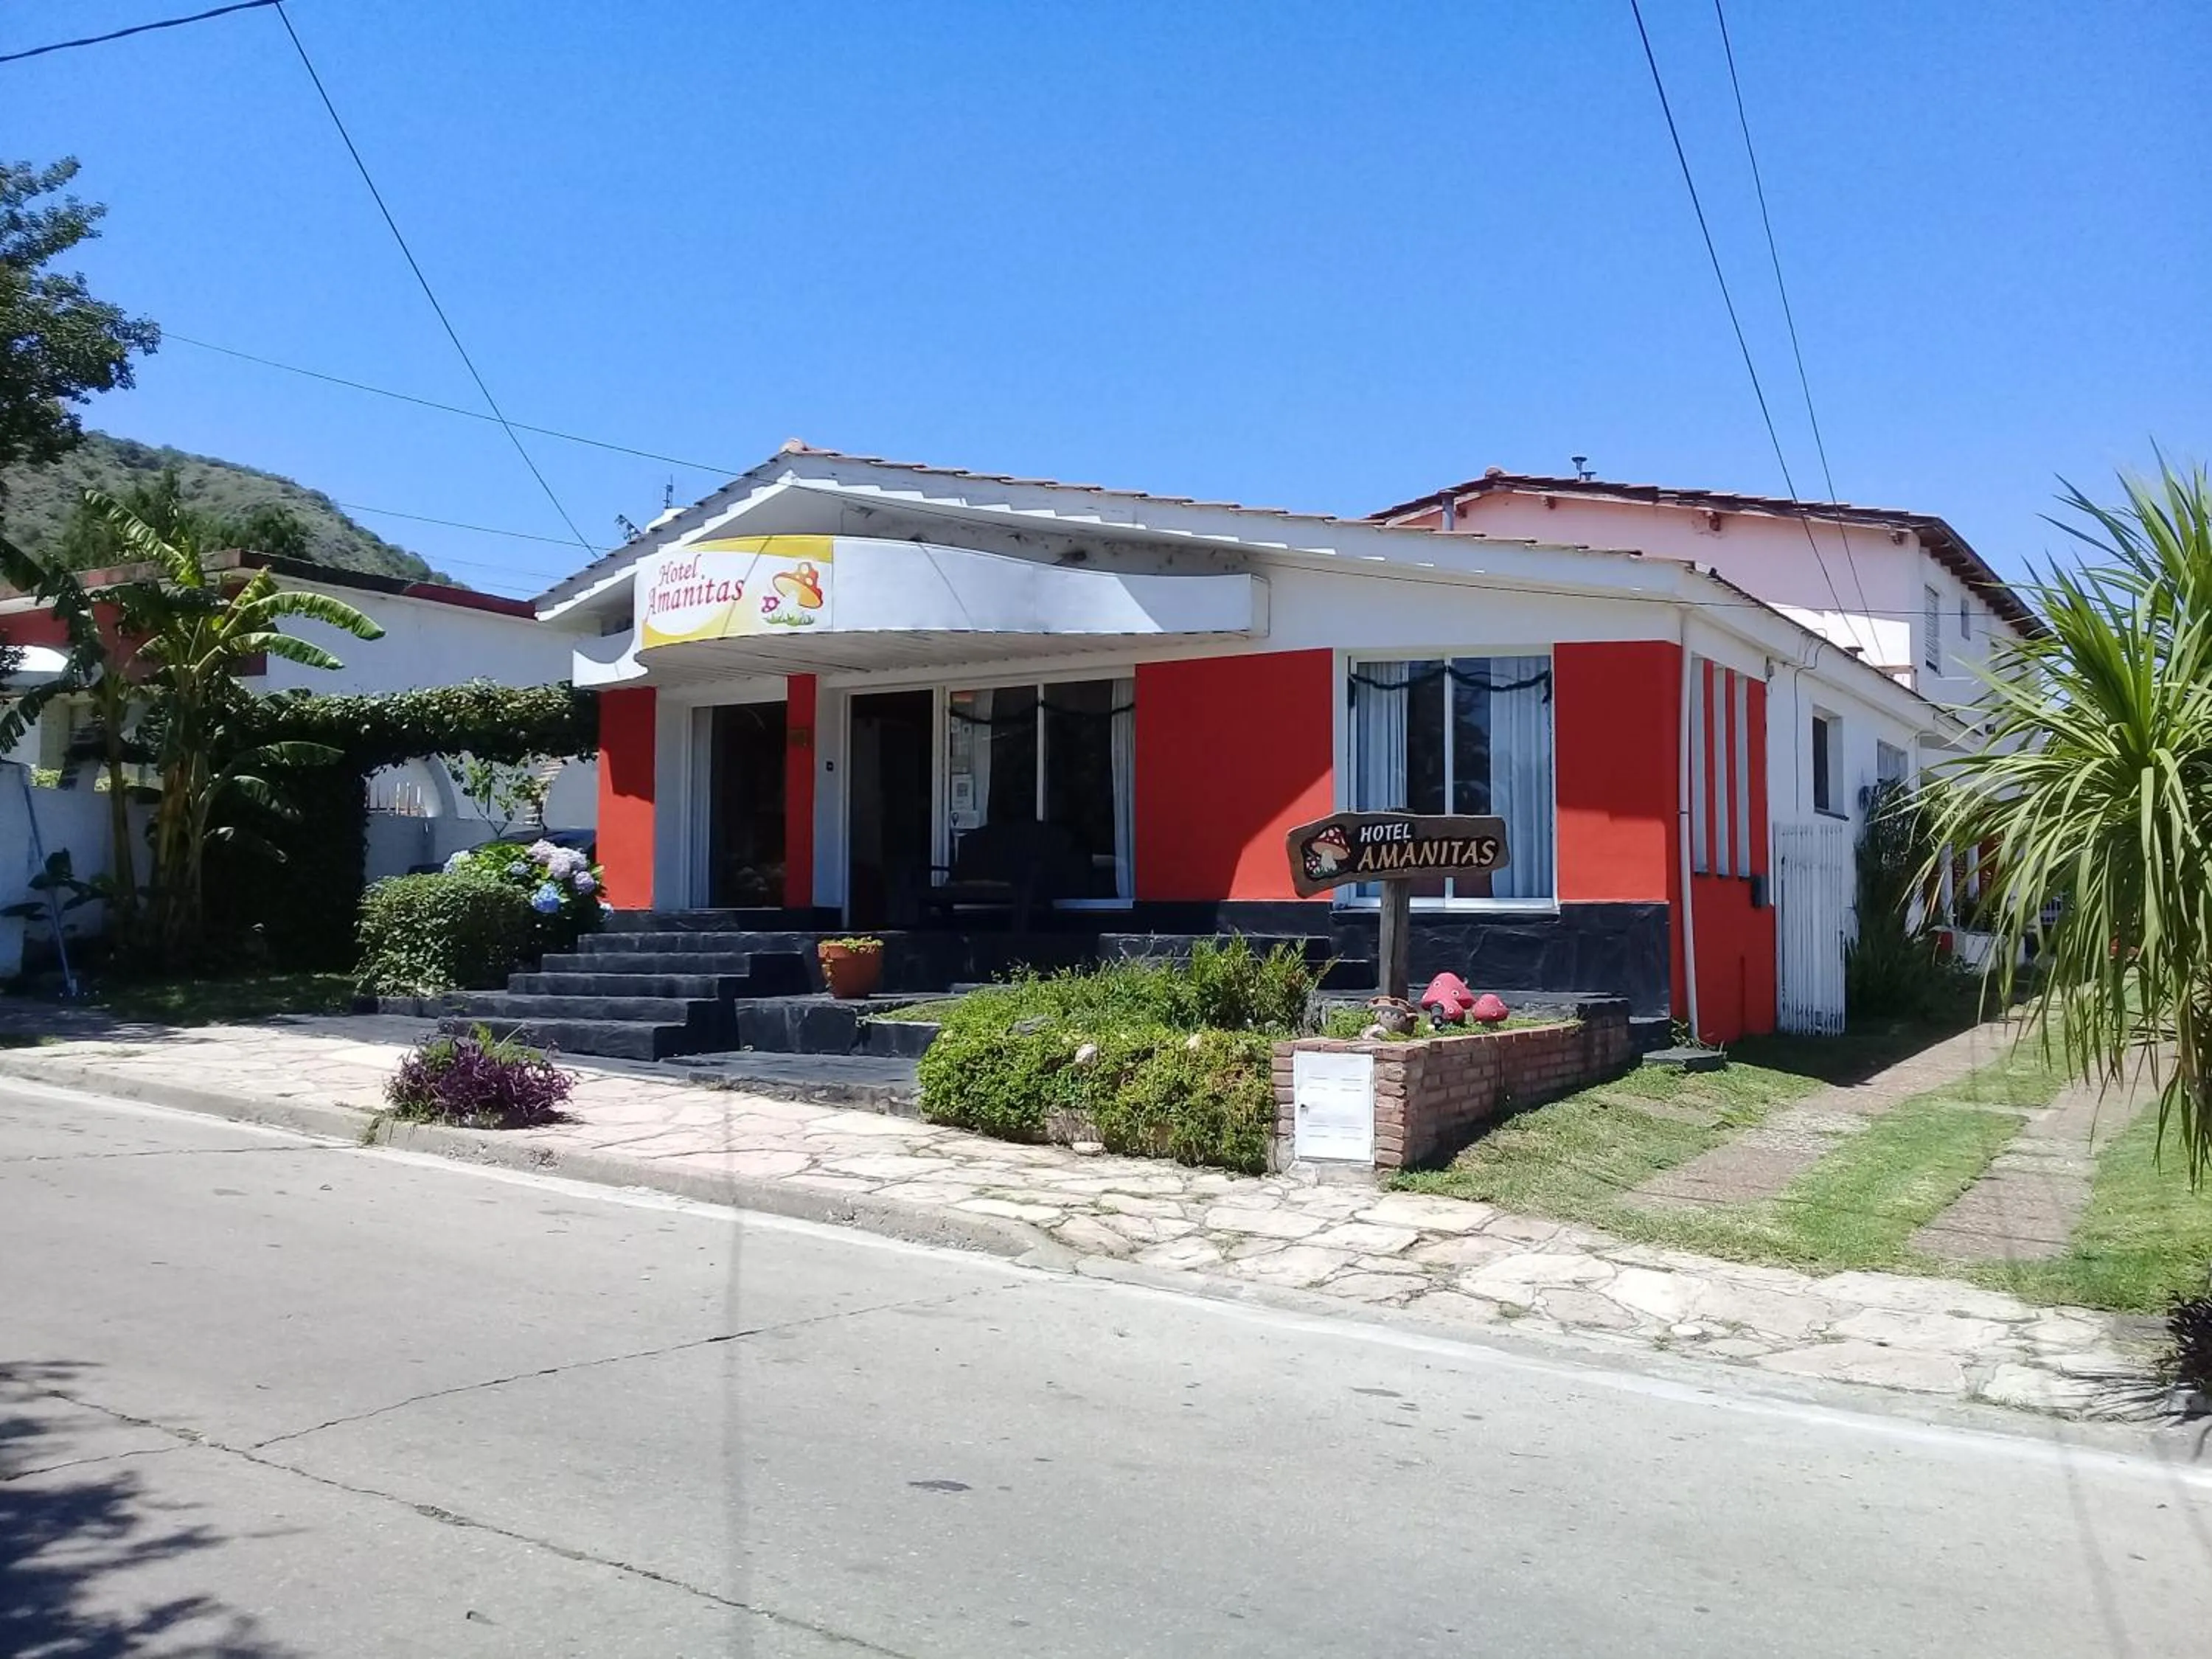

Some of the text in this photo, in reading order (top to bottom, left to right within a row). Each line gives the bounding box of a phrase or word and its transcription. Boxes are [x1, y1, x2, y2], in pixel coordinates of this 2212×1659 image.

[658, 553, 701, 586] Hotel
[648, 577, 745, 616] Amanitas
[1360, 822, 1411, 842] HOTEL
[1357, 840, 1496, 871] AMANITAS
